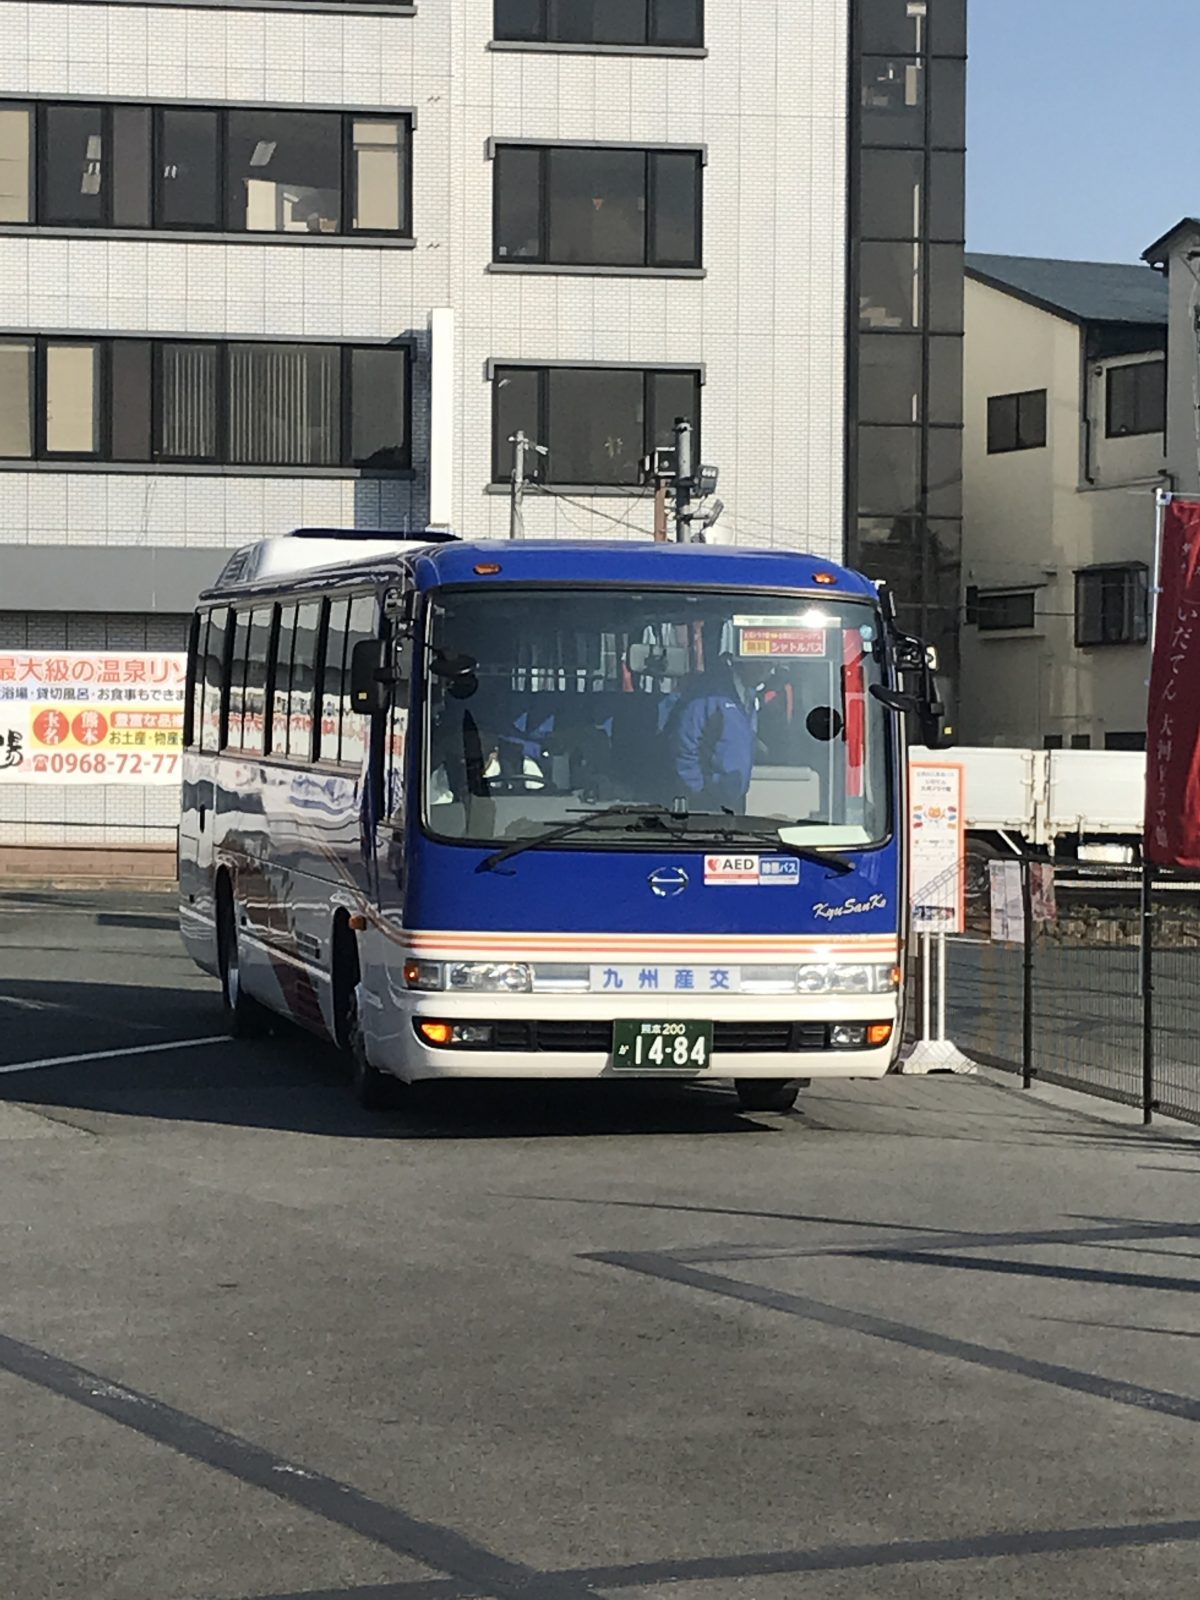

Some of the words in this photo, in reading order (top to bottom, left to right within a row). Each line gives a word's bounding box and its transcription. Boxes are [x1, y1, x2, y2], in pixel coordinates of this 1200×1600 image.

[1162, 606, 1199, 701] いだてん
[108, 731, 184, 746] お土産・物産
[51, 753, 184, 774] 0968-72-77
[723, 858, 754, 870] AED
[812, 893, 887, 921] KyuSanKo
[603, 968, 729, 989] 九州産交
[635, 1035, 706, 1065] 14-84
